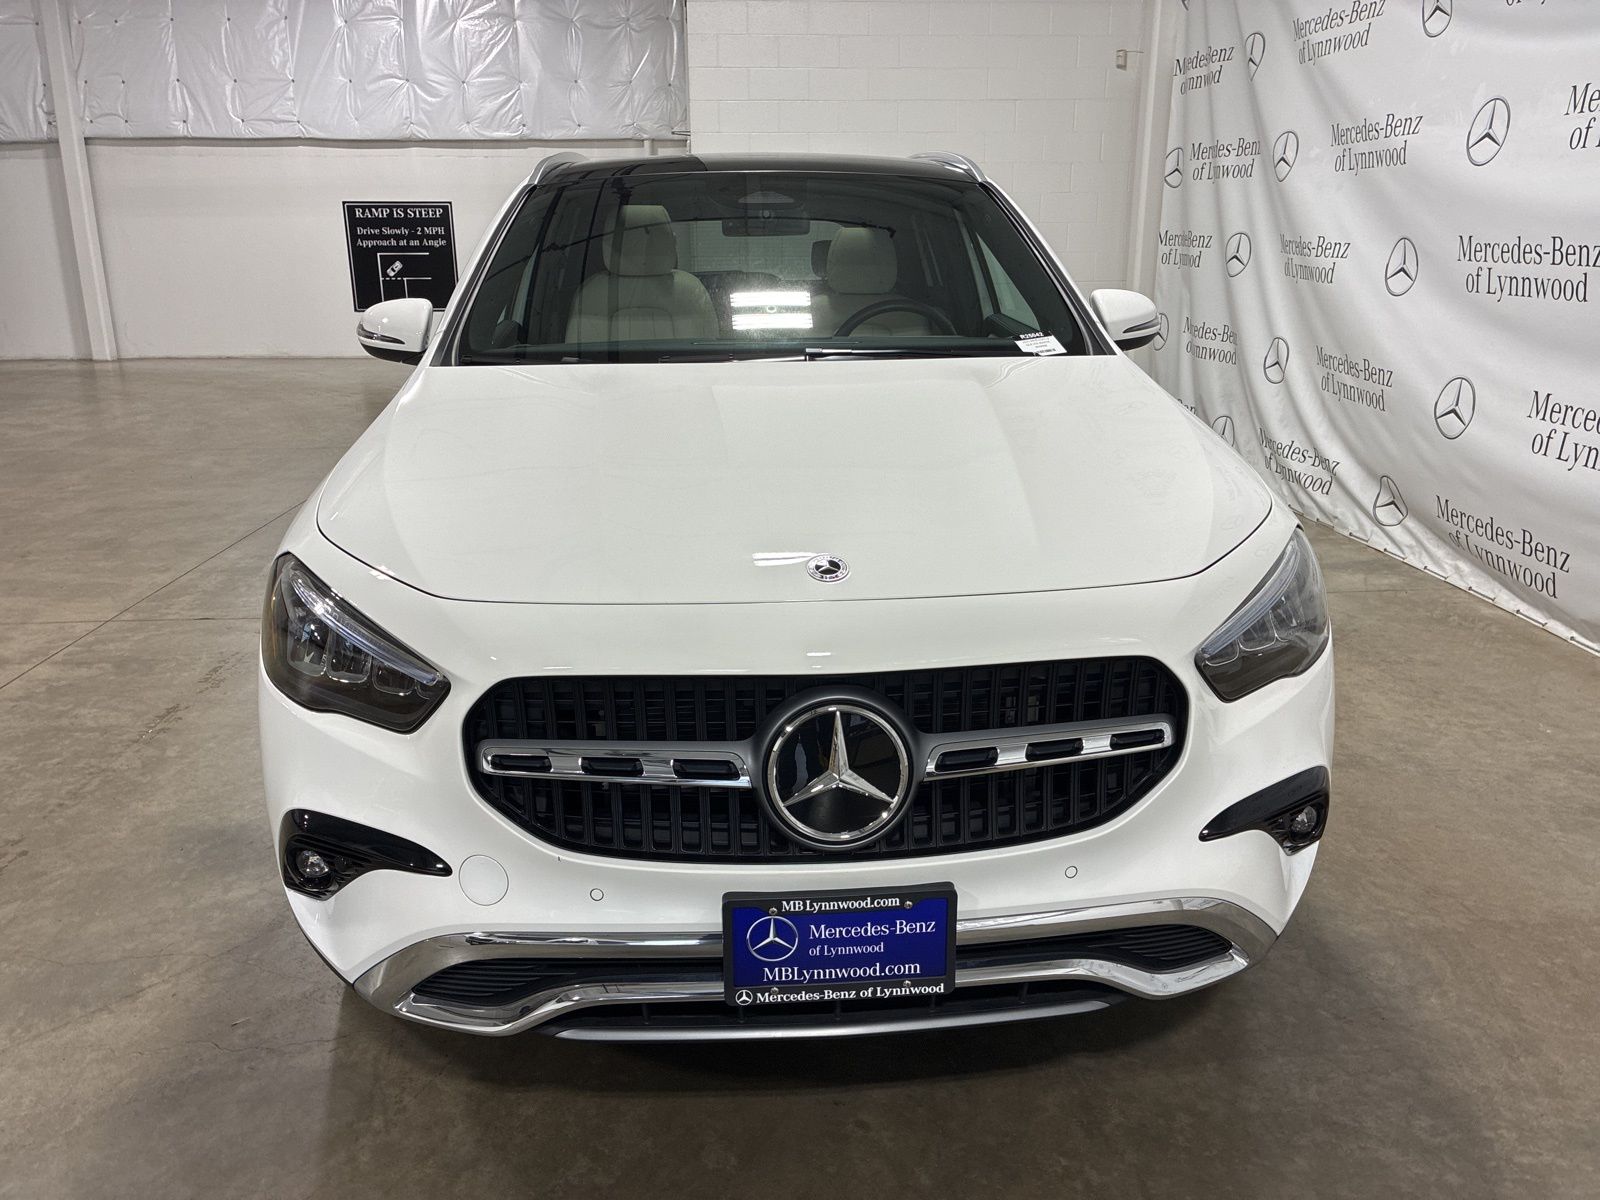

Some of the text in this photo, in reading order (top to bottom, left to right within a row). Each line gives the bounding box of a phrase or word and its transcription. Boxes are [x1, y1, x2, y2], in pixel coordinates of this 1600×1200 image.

[1293, 0, 1385, 41] Mercedes-Benz
[1307, 22, 1371, 66] Lynnwood
[1330, 113, 1423, 147] Mercedes-Benz
[1570, 116, 1596, 150] of
[1192, 162, 1206, 181] of
[1335, 139, 1407, 176] of Lynnwood
[355, 208, 443, 218] RAMP IS STEEP
[356, 227, 380, 235] Drive
[381, 227, 409, 236] Slowly
[417, 227, 422, 235] 2
[424, 227, 445, 235] MPH
[356, 238, 397, 248] Approach
[400, 238, 407, 246] at
[422, 238, 447, 248] Angle
[1280, 233, 1351, 259] Mercedes-Benz
[1161, 248, 1173, 265] of
[1457, 235, 1600, 268] Mercedes-Benz
[1466, 266, 1588, 303] of Lynnwood
[1316, 345, 1393, 388] Mercedes-Benz
[1321, 371, 1386, 412] of Lynnwood
[1531, 428, 1557, 457] of
[1436, 494, 1570, 573] Mercedes-Benz
[1464, 533, 1558, 599] Lynnwood
[809, 919, 936, 939] Mercedes-Benz
[808, 942, 884, 958] of Lynnwood
[763, 962, 921, 984] MBLynnwood.com
[755, 983, 945, 1004] Mercedes-Benz of Lynnwood
